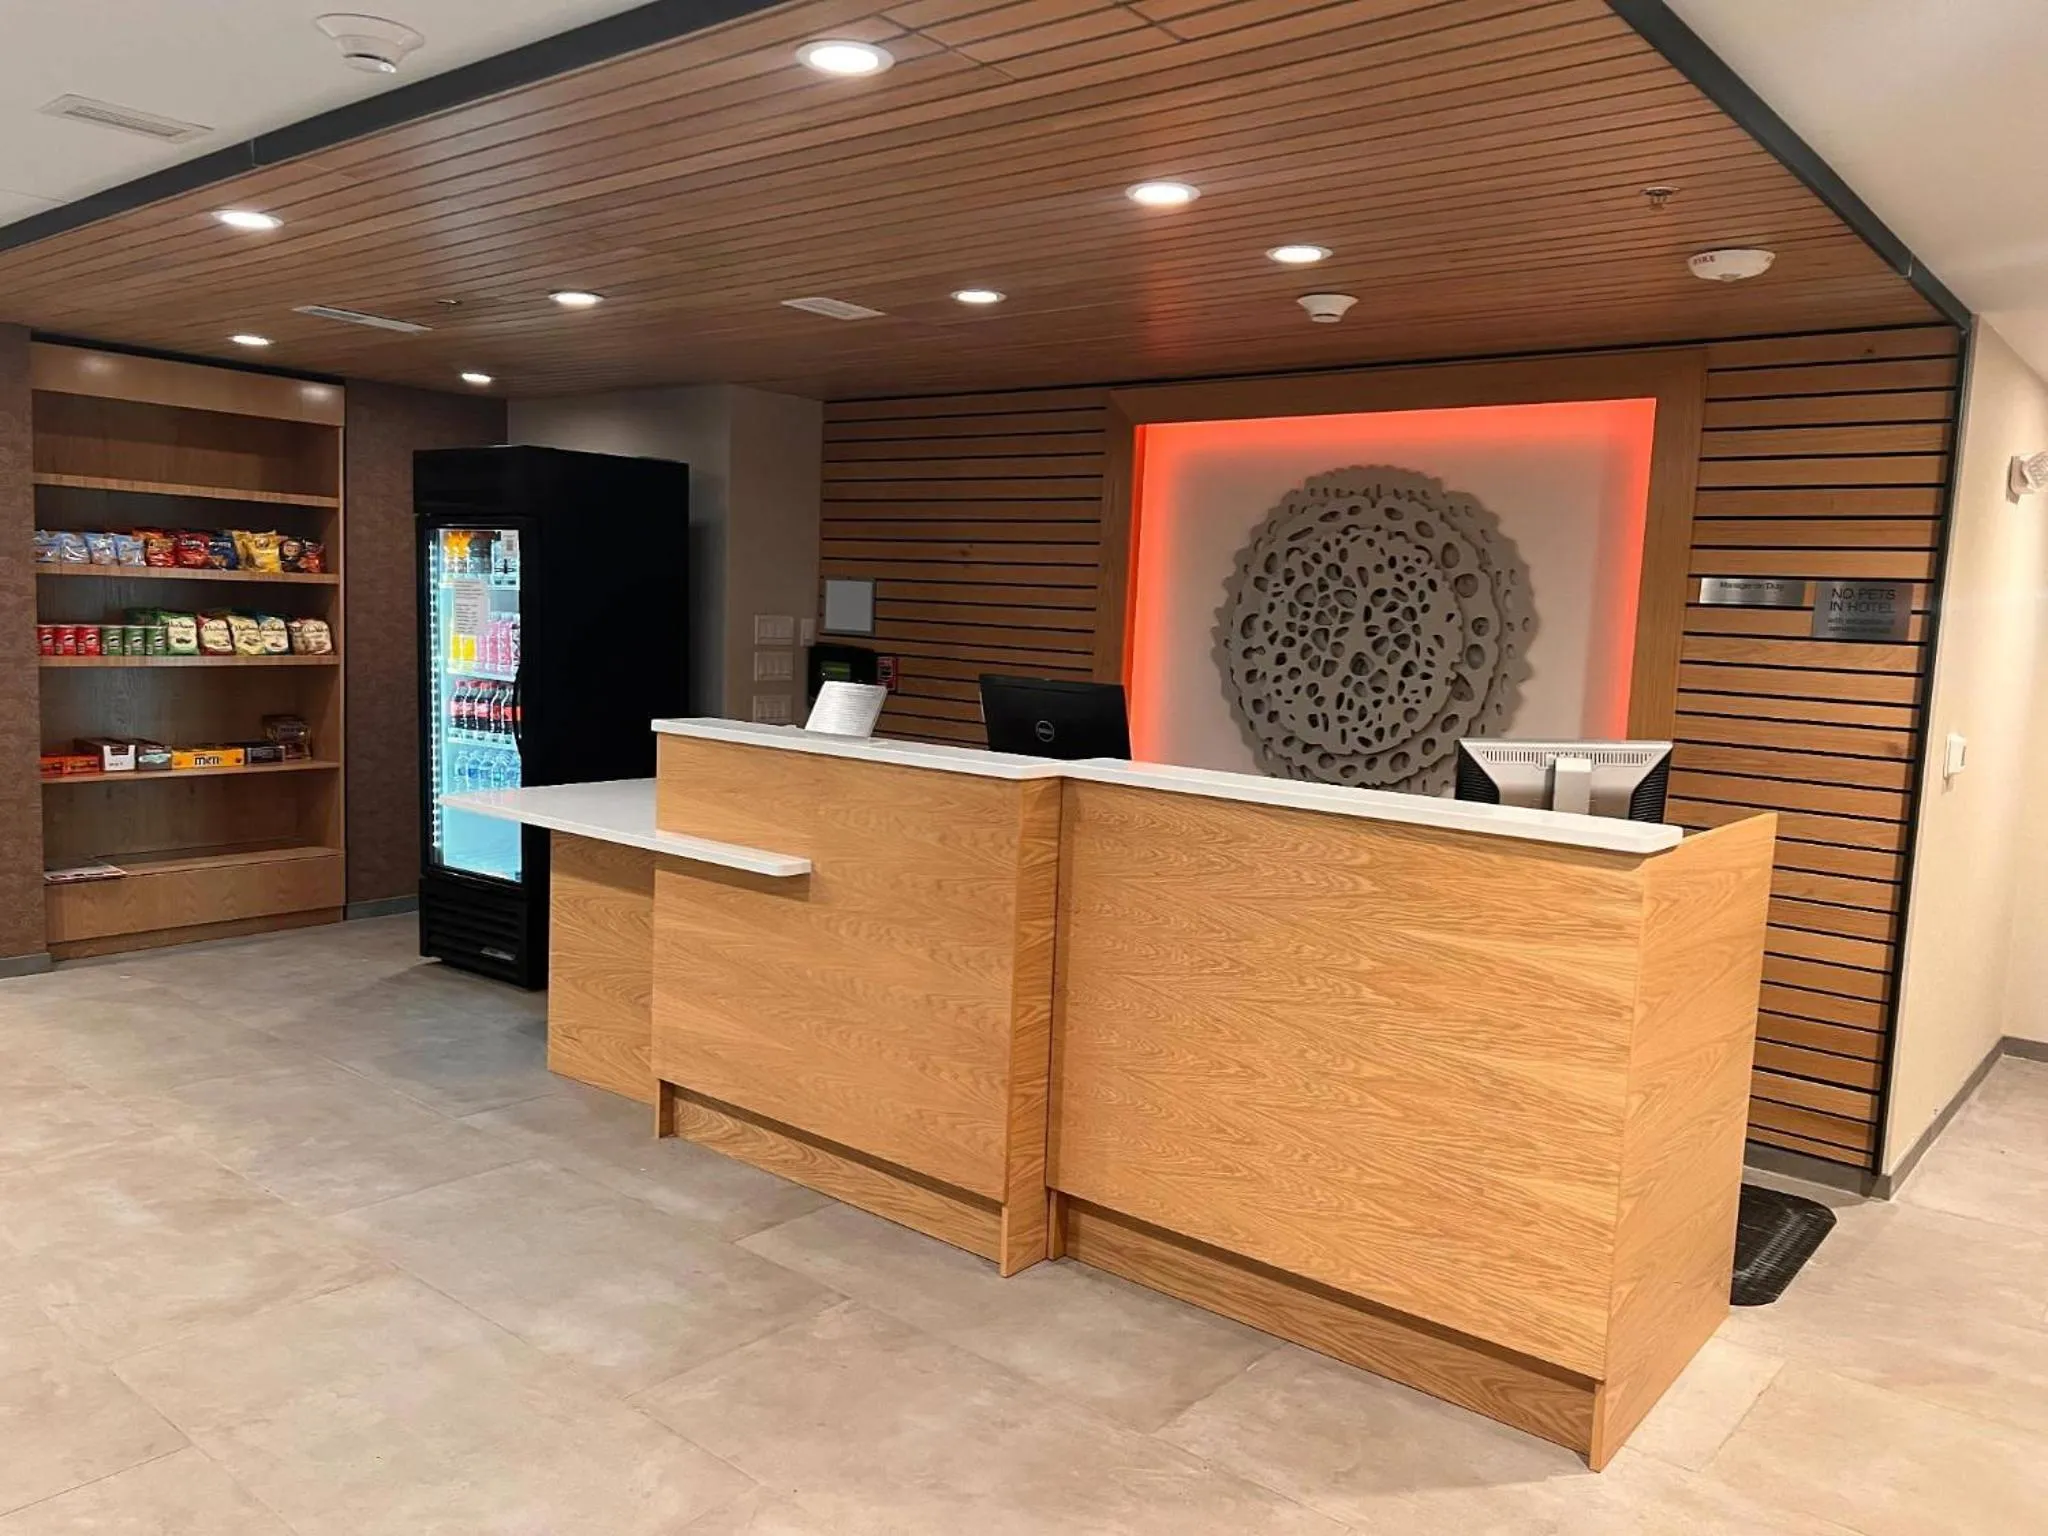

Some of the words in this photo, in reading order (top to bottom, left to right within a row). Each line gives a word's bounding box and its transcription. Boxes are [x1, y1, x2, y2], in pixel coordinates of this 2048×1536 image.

[1693, 255, 1715, 265] FIRE
[1832, 588, 1855, 600] NO
[1859, 588, 1897, 601] PETS
[1830, 601, 1844, 612] IN
[1848, 602, 1896, 614] HOTEL
